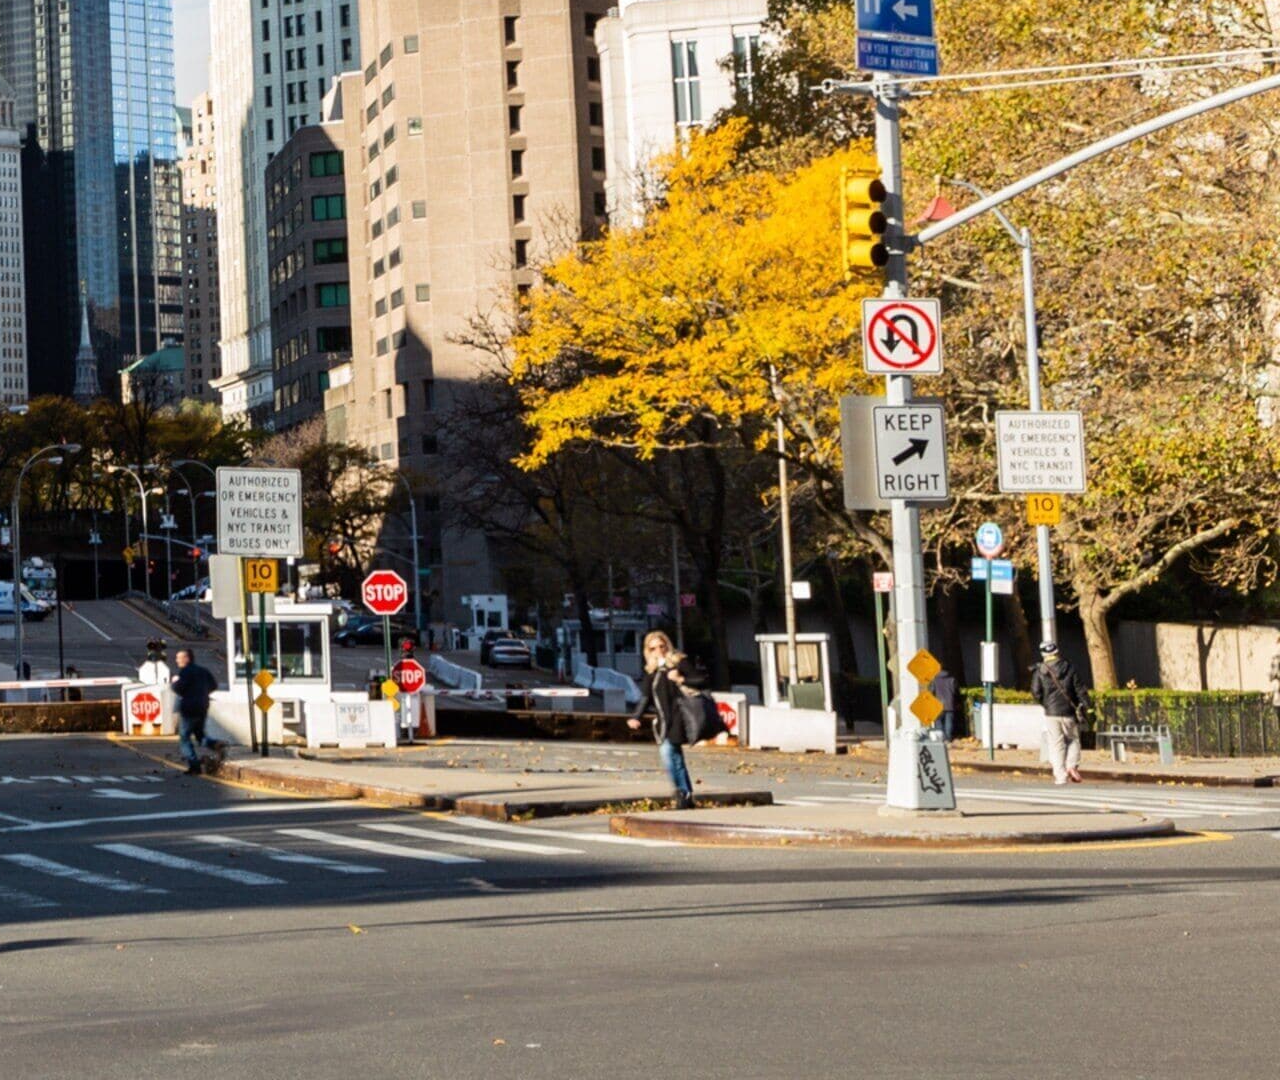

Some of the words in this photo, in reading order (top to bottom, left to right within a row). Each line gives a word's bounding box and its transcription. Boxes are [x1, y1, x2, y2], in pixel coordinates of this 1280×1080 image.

[873, 43, 889, 55] YORK
[884, 414, 933, 431] KEEP
[1008, 420, 1071, 429] AUTHORIZED
[1003, 433, 1016, 442] OR
[1021, 433, 1077, 443] EMERGENCY
[1011, 447, 1057, 457] VEHICLES
[1063, 447, 1071, 457] &
[1009, 461, 1029, 471] NYC
[1034, 461, 1074, 471] TRANSIT
[228, 476, 290, 488] AUTHORIZED
[884, 474, 940, 491] RIGHT
[1012, 475, 1044, 485] BUSES
[1049, 475, 1073, 485] ONLY
[222, 490, 236, 501] OR
[238, 491, 297, 503] EMERGENCY
[1034, 497, 1054, 512] 10
[230, 507, 277, 519] VEHICLES
[281, 508, 289, 519] &
[227, 523, 247, 534] NYC
[251, 523, 291, 534] TRANSIT
[228, 537, 261, 549] BUSES
[264, 538, 290, 550] ONLY
[251, 563, 272, 580] 10
[366, 584, 404, 602] STOP
[393, 670, 423, 684] STOP
[132, 701, 159, 715] STOP
